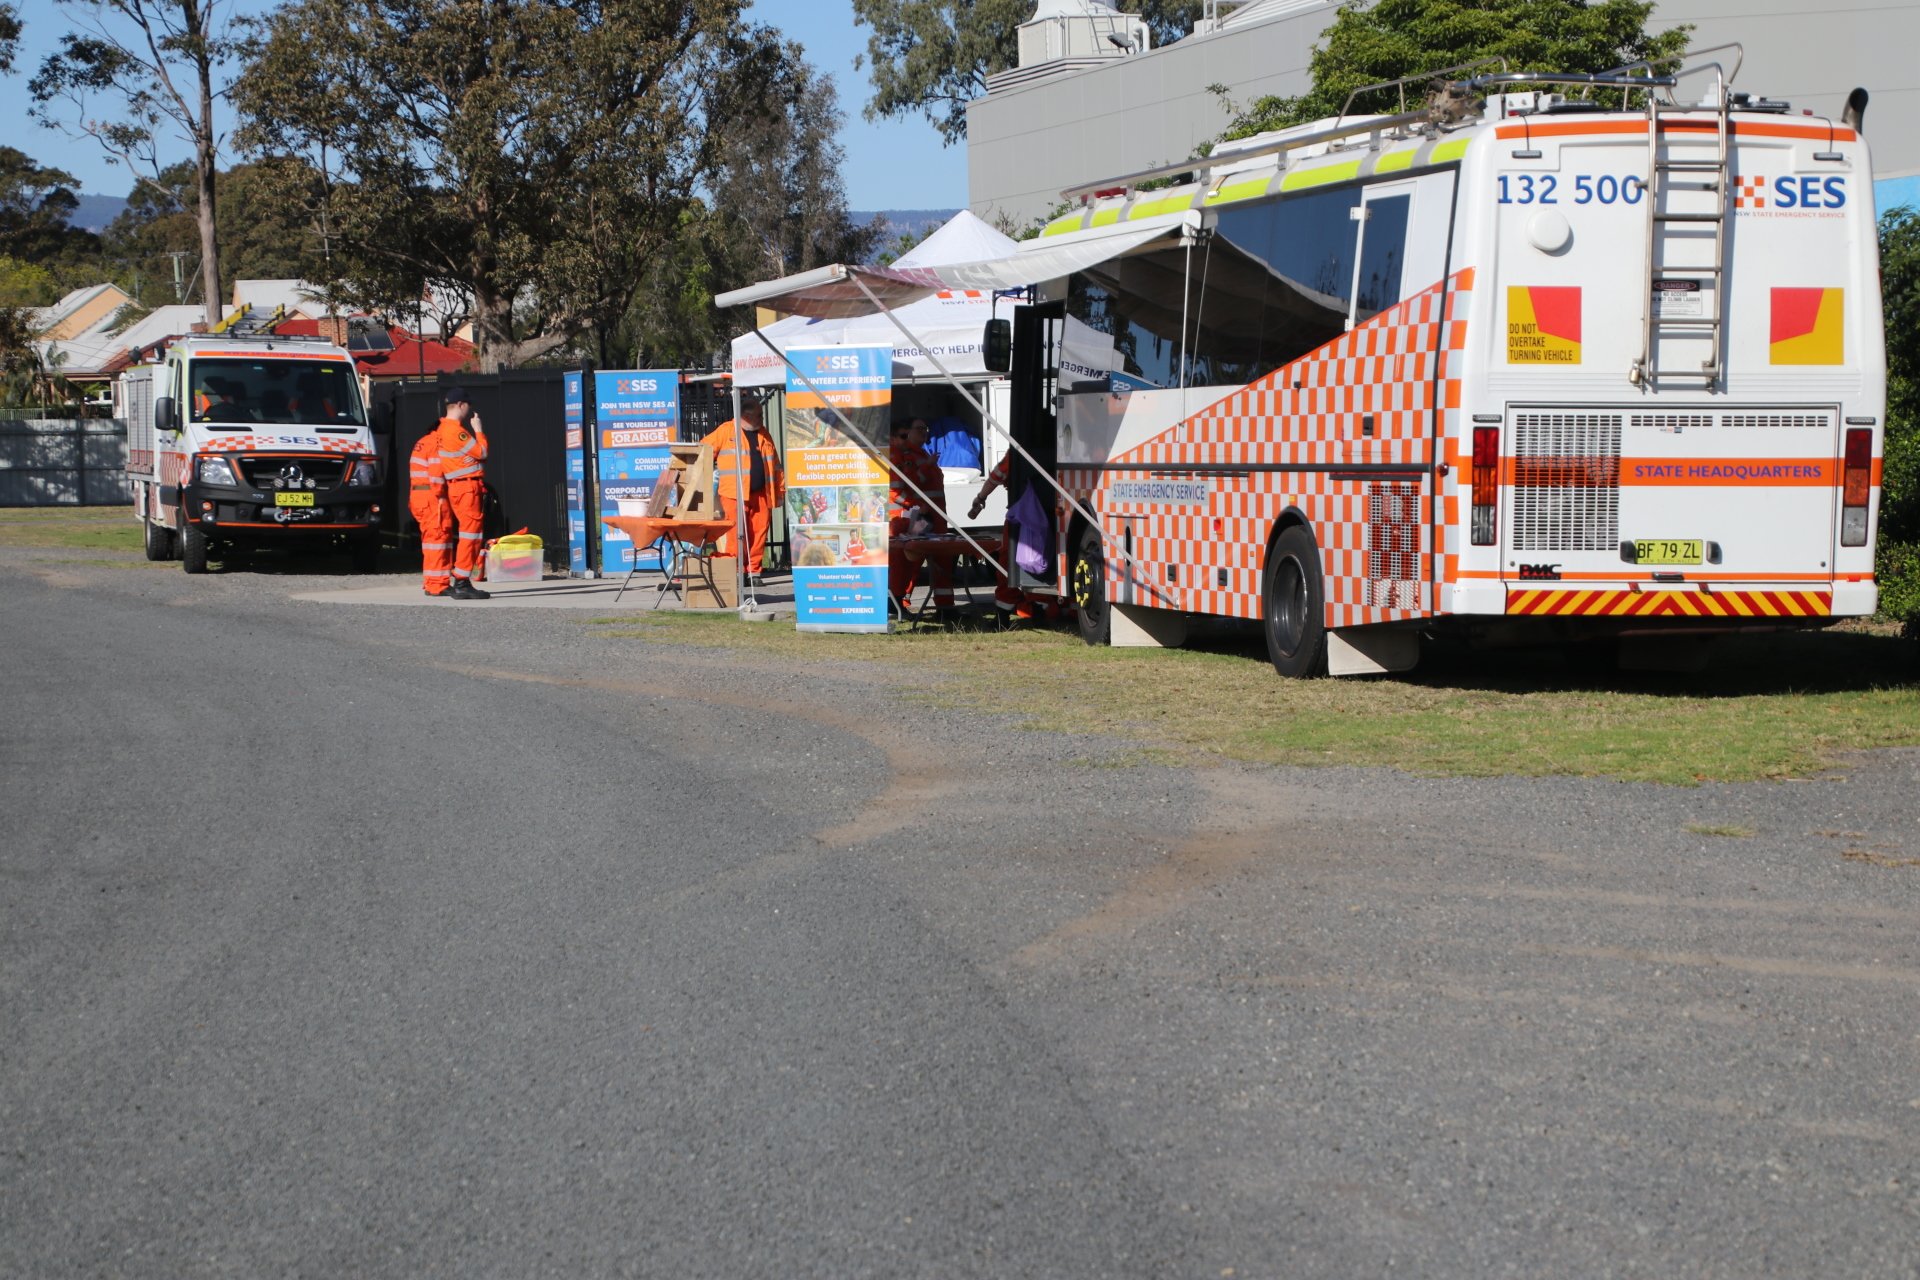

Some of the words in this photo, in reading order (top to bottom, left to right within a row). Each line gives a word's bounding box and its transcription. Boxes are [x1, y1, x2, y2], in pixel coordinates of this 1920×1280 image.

[1497, 174, 1557, 204] 132
[1574, 174, 1643, 204] 500
[1774, 175, 1846, 208] SES
[1509, 323, 1520, 334] DO
[1521, 323, 1537, 334] NOT
[1509, 336, 1546, 347] OVERTAKE
[891, 346, 945, 358] MERGENCY
[948, 344, 975, 354] HELP
[1509, 349, 1542, 360] TURNING
[1543, 349, 1573, 360] VEHICLE
[831, 355, 859, 370] SES
[631, 379, 657, 391] SES
[792, 377, 837, 386] VOUNTEER
[839, 375, 886, 385] EXPERIENCE
[279, 436, 318, 445] SES
[614, 432, 665, 443] ORANGE
[826, 453, 847, 462] great
[806, 463, 826, 471] learn
[1635, 465, 1683, 477] STATE
[1689, 465, 1821, 479] HEADQUARTERS
[797, 472, 825, 480] flexible
[827, 471, 880, 482] opportunities
[605, 486, 650, 494] CORPORATE
[1113, 483, 1132, 497] STATE
[1134, 483, 1174, 499] EMERGENCY
[1176, 484, 1205, 500] SERVICE
[276, 494, 287, 503] CJ
[289, 494, 300, 503] 52
[1637, 543, 1655, 558] BF
[1661, 543, 1677, 558] 79
[1683, 543, 1700, 558] ZL
